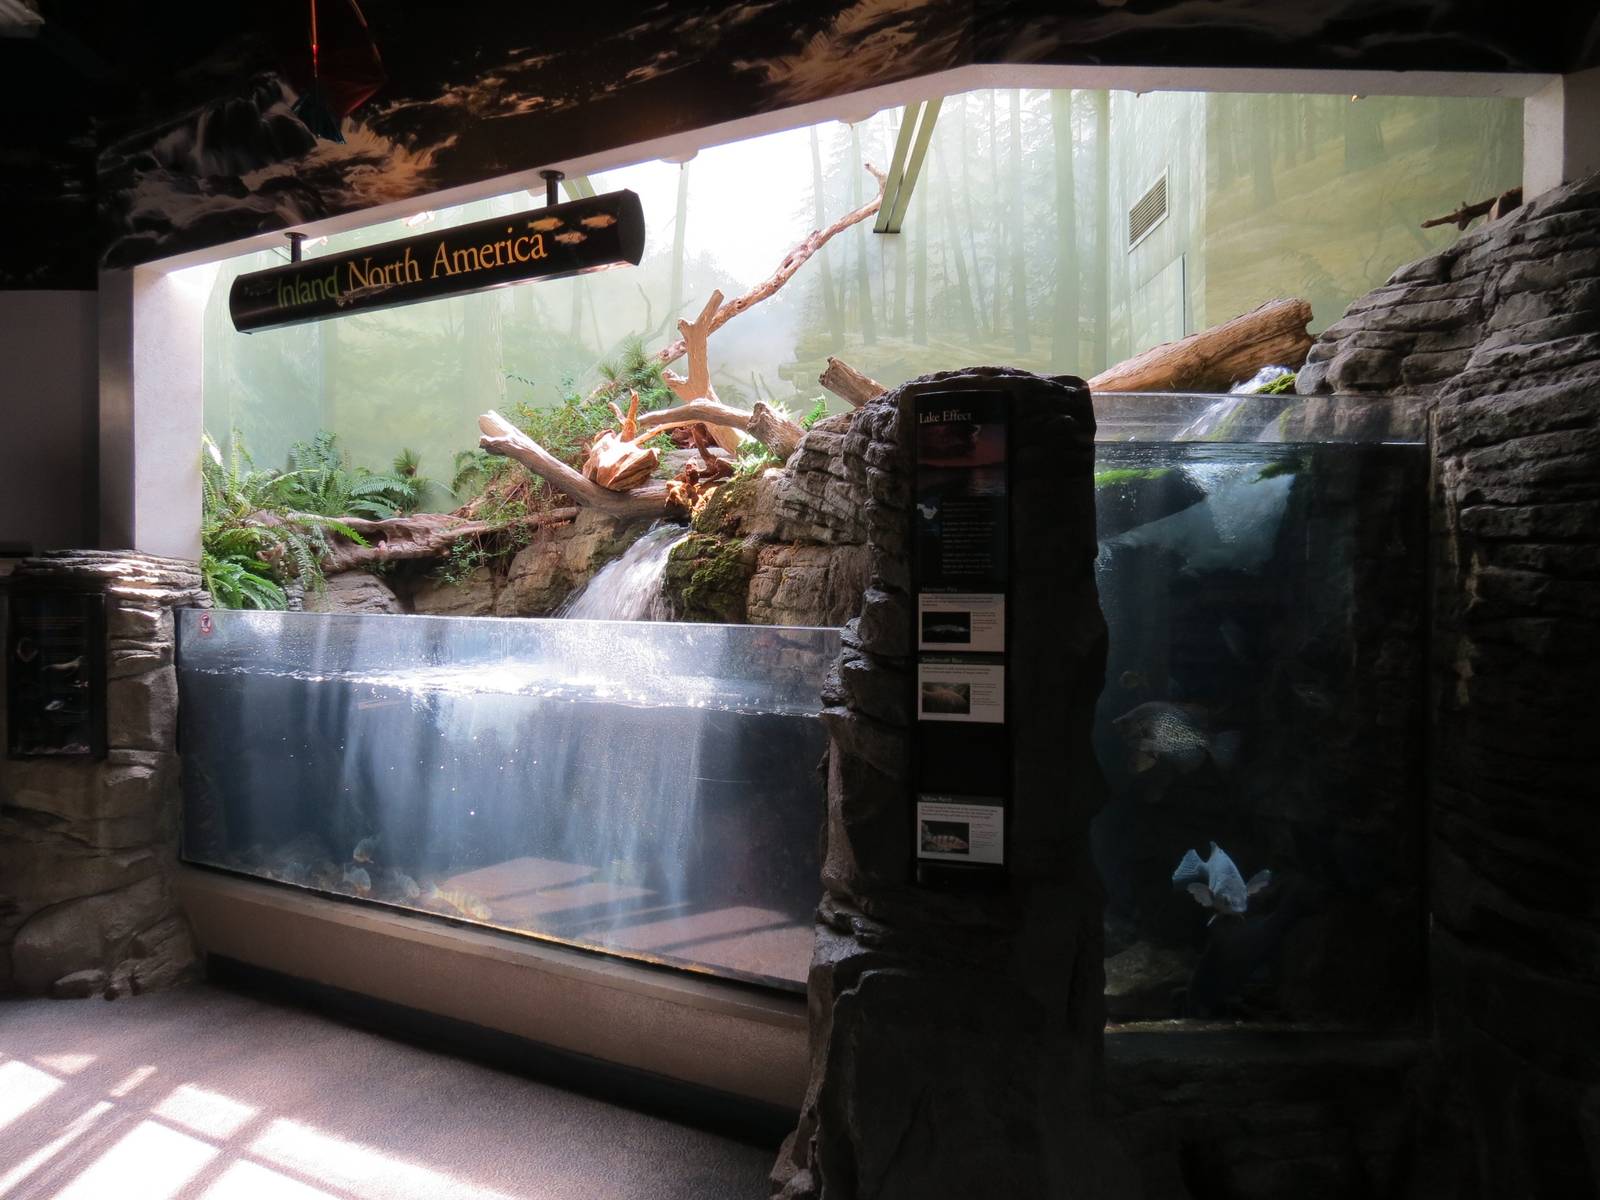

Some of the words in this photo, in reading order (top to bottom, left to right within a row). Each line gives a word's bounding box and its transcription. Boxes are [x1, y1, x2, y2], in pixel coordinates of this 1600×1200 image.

[277, 267, 340, 309] Inland
[347, 247, 422, 289] North
[429, 225, 548, 279] America
[919, 411, 942, 425] Lake
[943, 408, 972, 423] Effect
